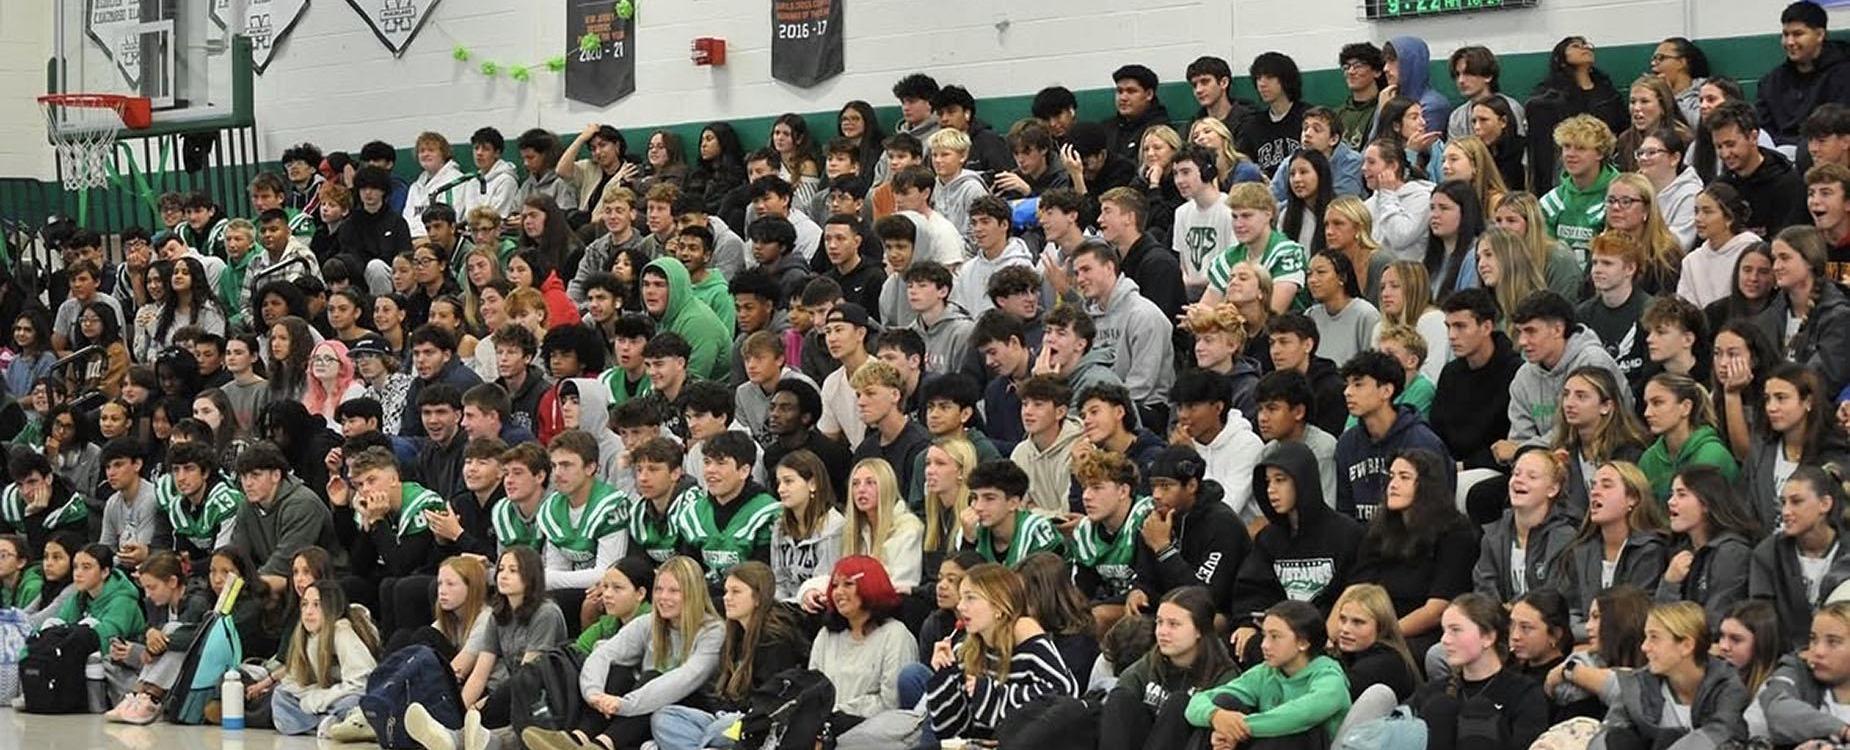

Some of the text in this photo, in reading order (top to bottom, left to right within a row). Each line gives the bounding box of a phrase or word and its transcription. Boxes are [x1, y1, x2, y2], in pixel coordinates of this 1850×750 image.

[778, 23, 810, 39] 2016
[213, 492, 236, 513] 13
[1033, 523, 1056, 547] 12
